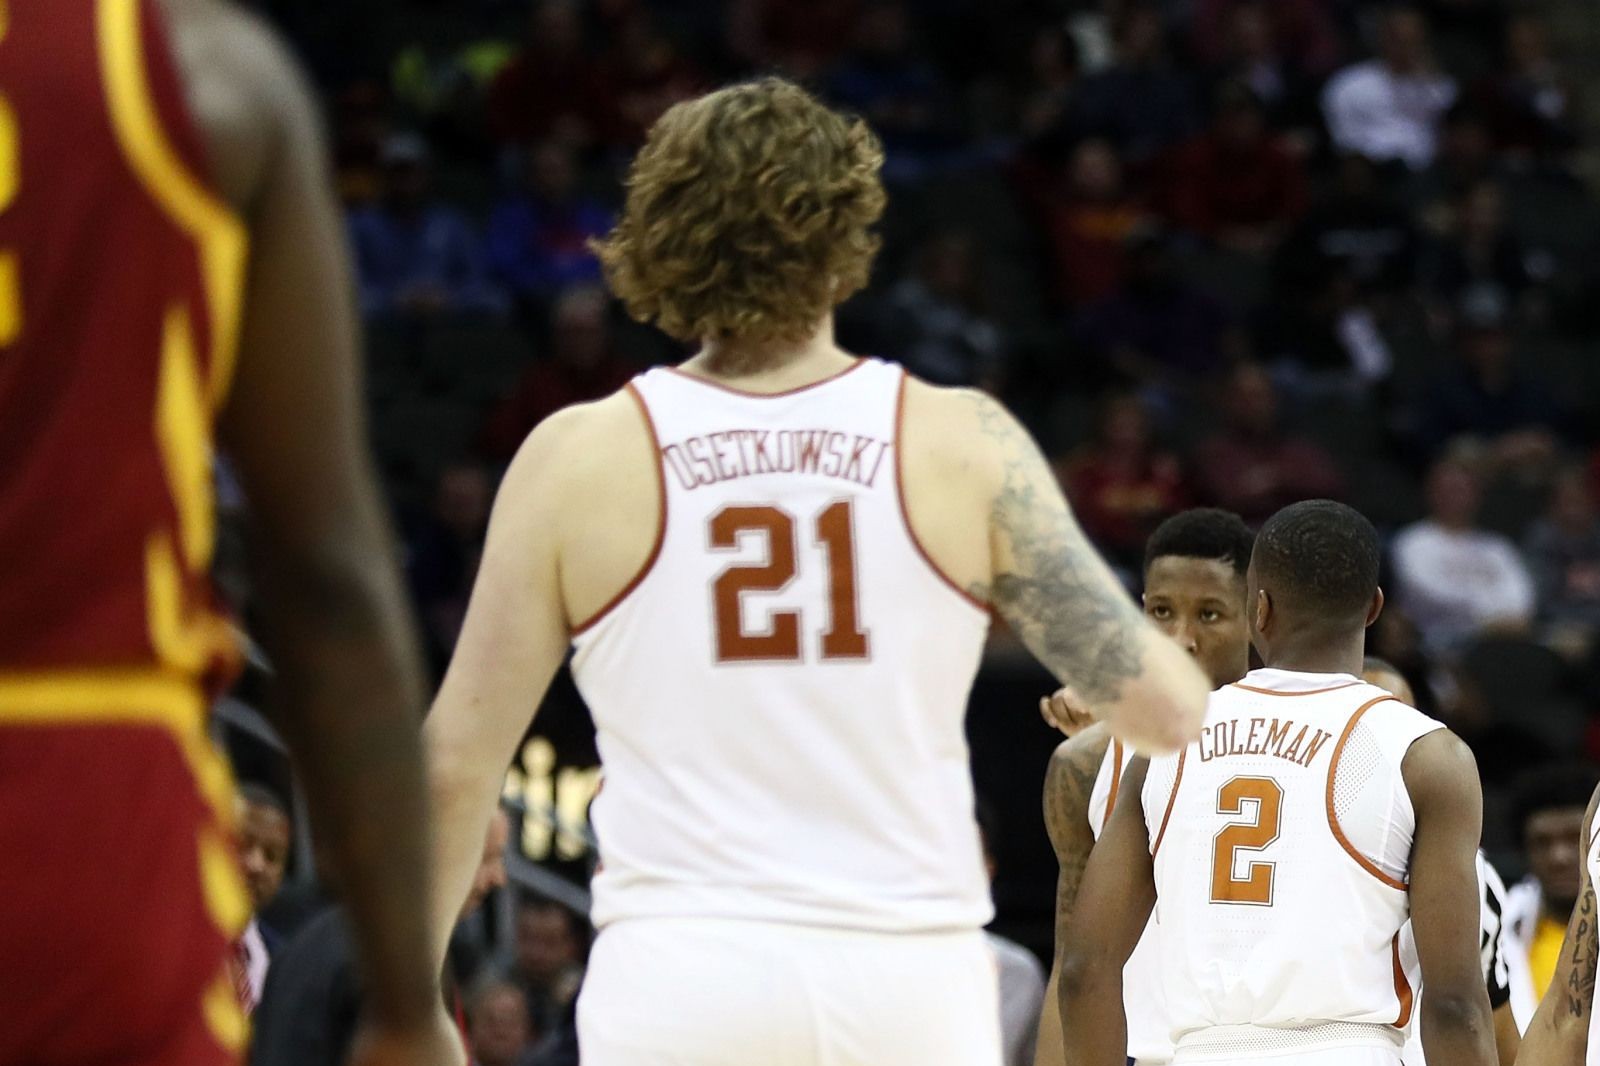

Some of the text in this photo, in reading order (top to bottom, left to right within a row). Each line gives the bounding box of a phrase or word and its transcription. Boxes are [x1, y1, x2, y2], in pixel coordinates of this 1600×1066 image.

[664, 429, 889, 491] OSETKOWSKI
[705, 496, 872, 667] 21
[1200, 718, 1332, 768] COLEMAN
[1208, 774, 1285, 907] 2
